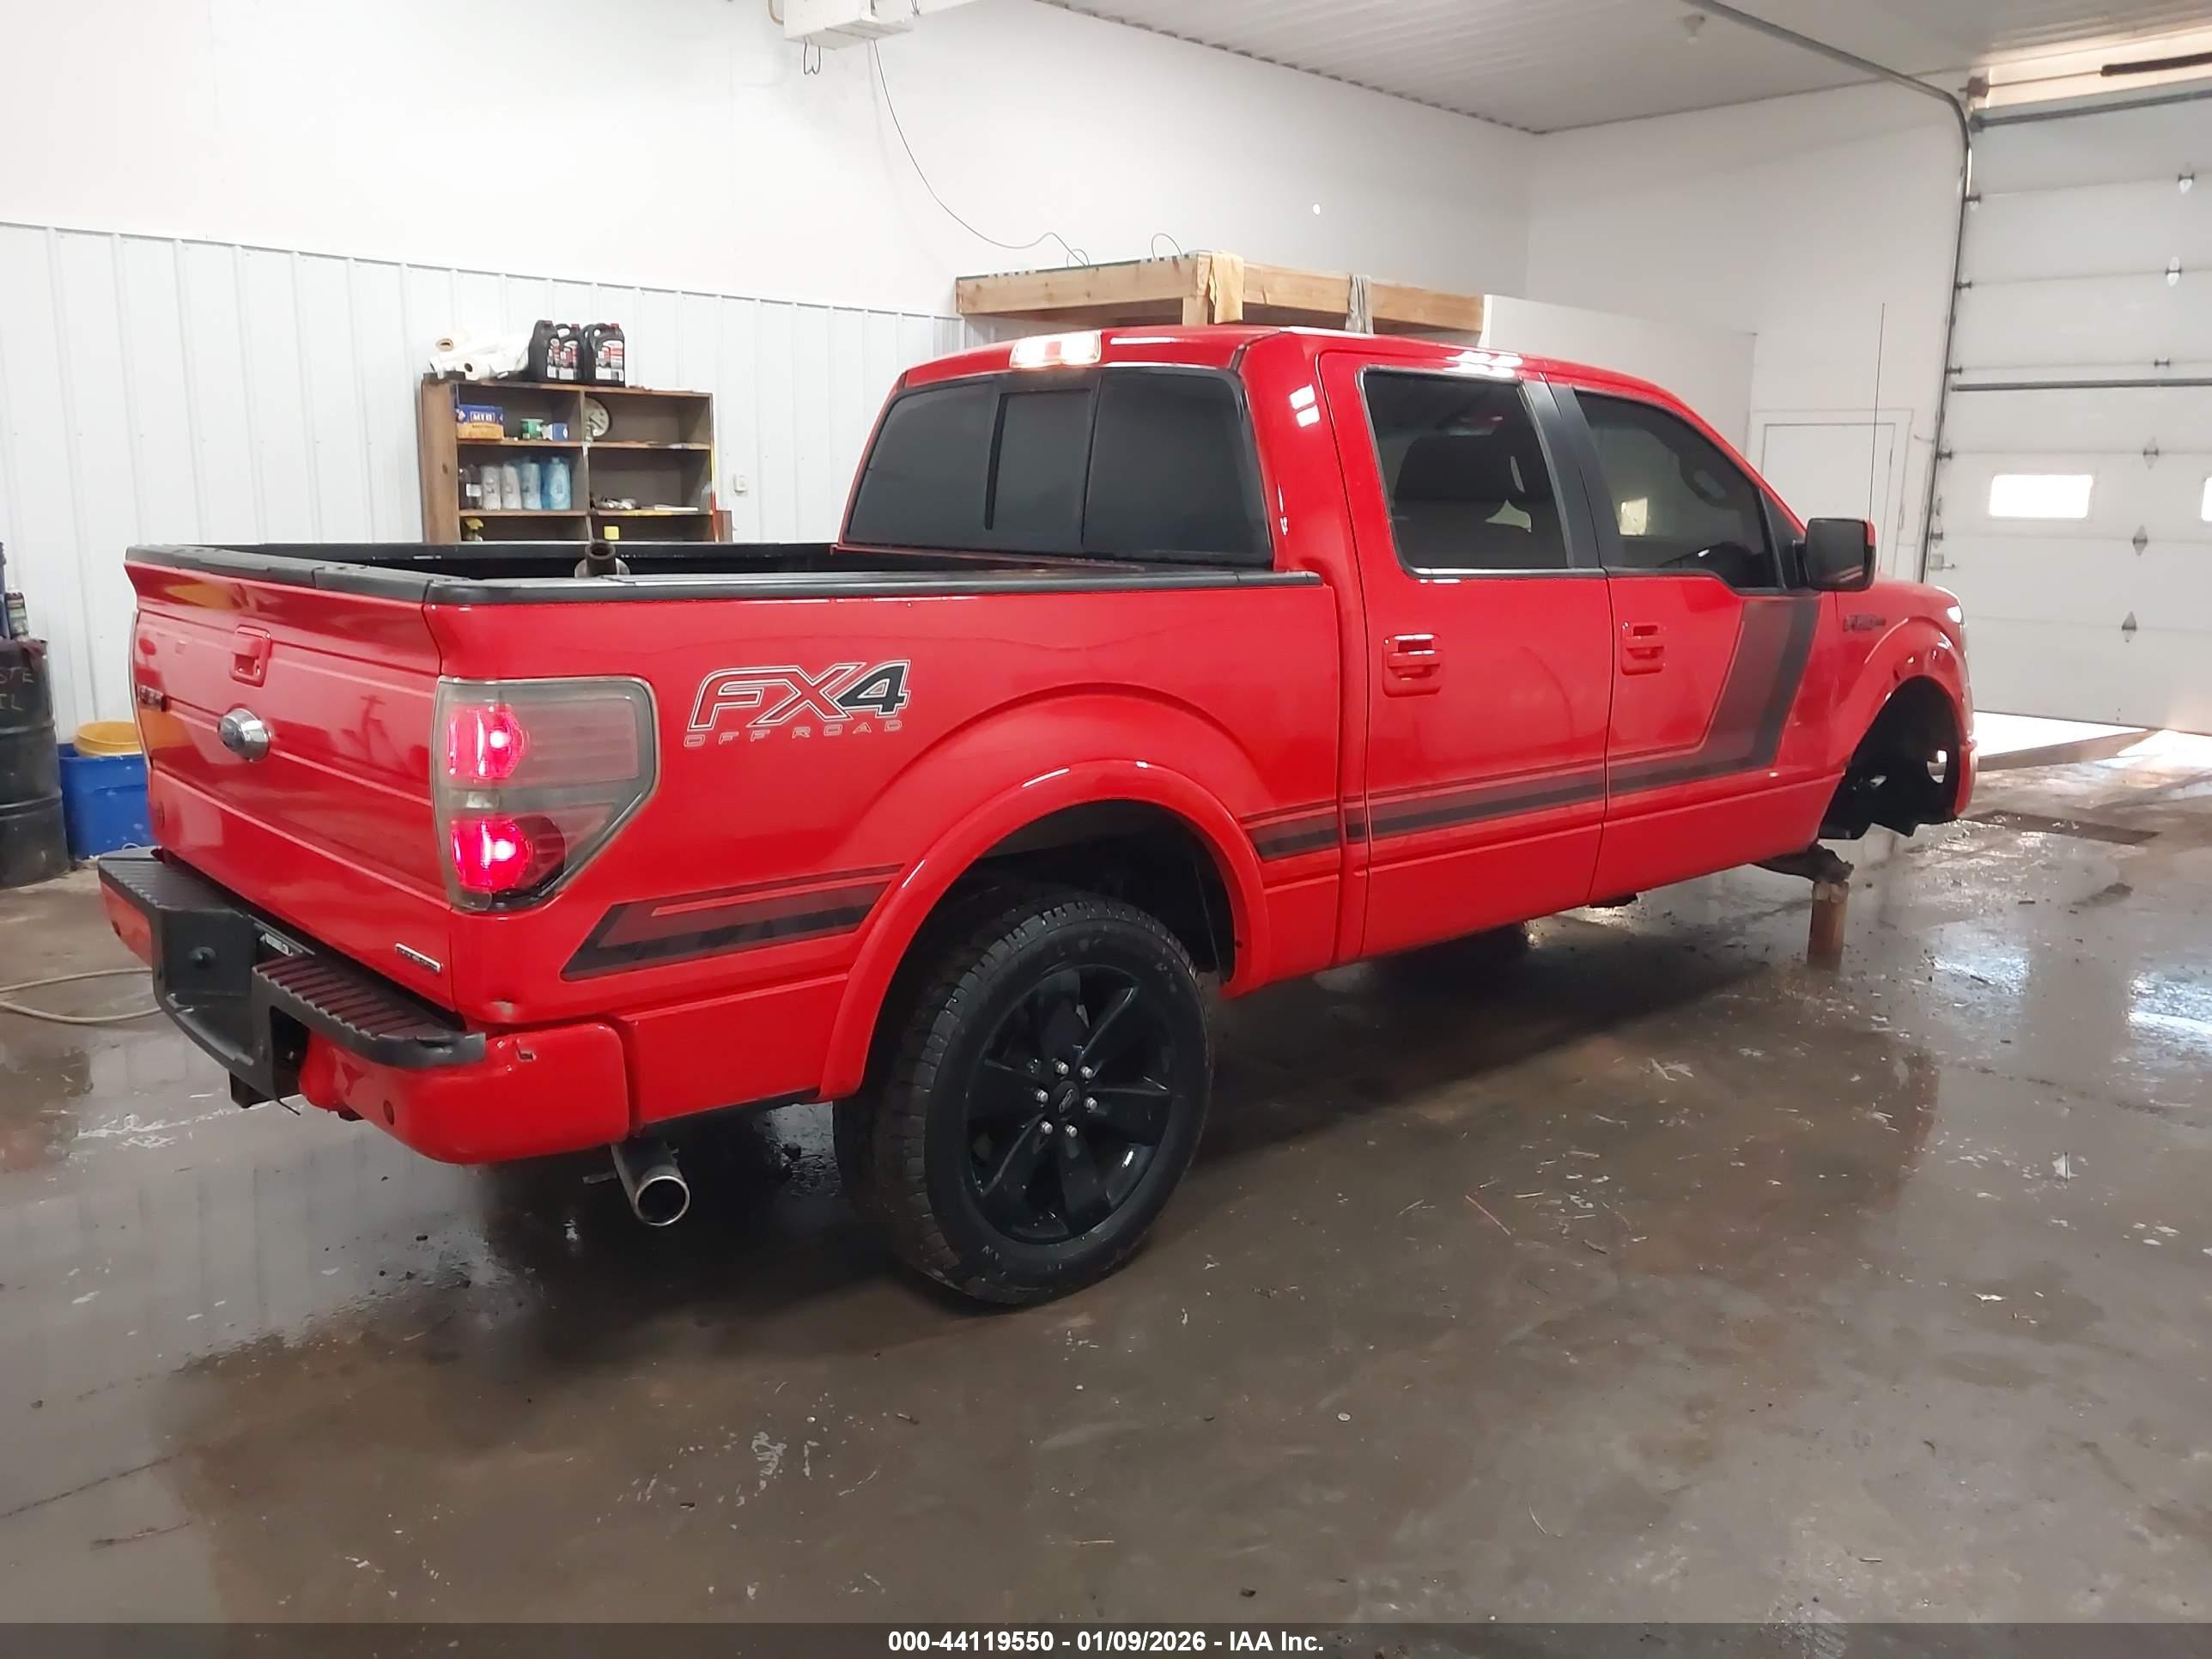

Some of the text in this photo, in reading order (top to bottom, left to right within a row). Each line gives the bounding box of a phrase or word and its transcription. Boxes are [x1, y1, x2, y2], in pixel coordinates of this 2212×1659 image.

[686, 659, 911, 732] FX4
[684, 720, 903, 748] OFF ROAD
